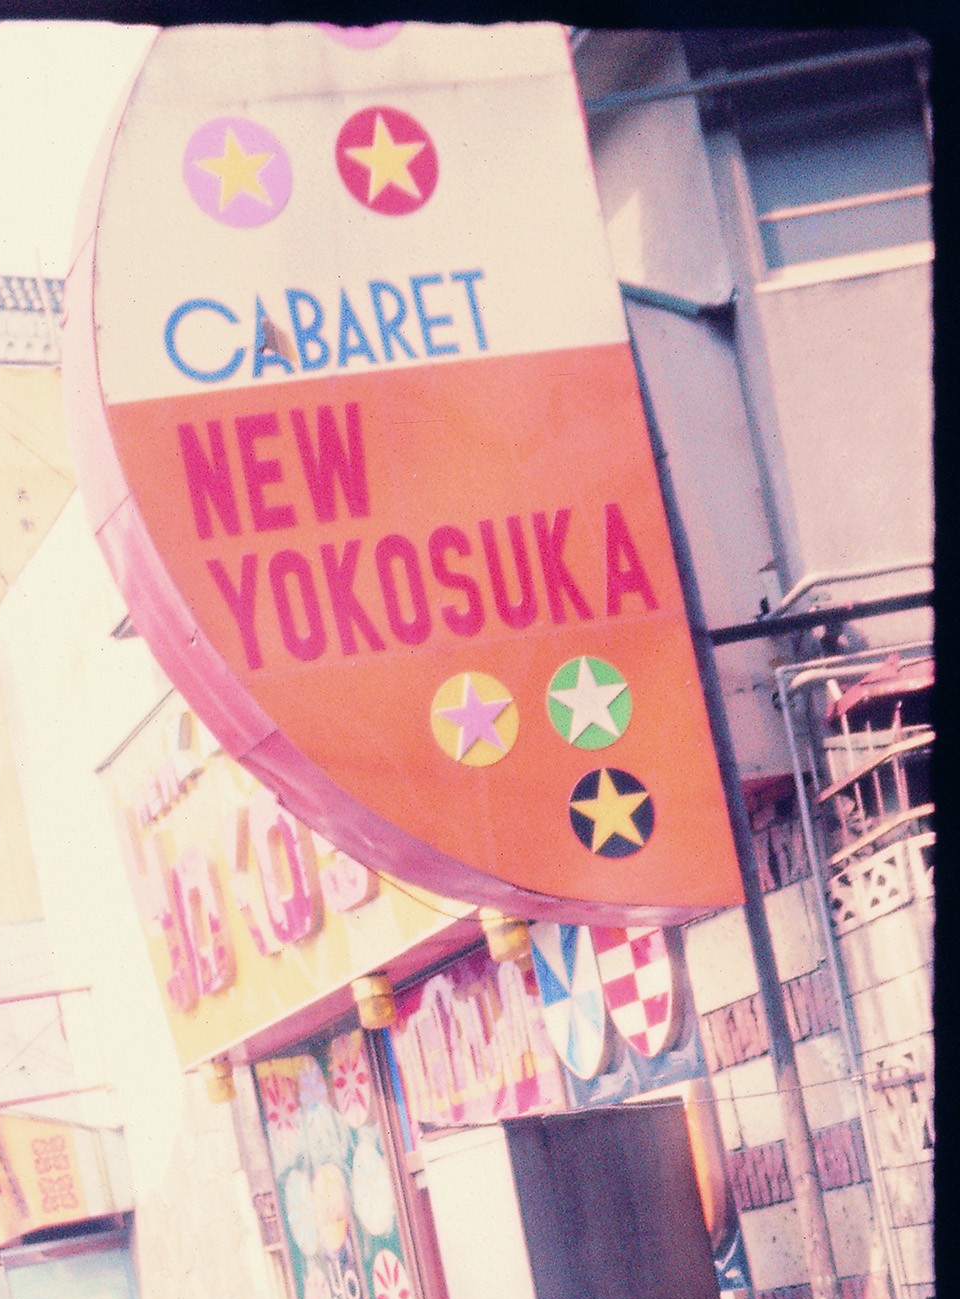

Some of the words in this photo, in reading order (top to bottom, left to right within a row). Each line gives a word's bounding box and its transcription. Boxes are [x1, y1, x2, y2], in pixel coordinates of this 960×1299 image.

[162, 269, 489, 385] CABARET
[177, 402, 371, 540] NEW
[205, 502, 660, 671] YOKOSUKA
